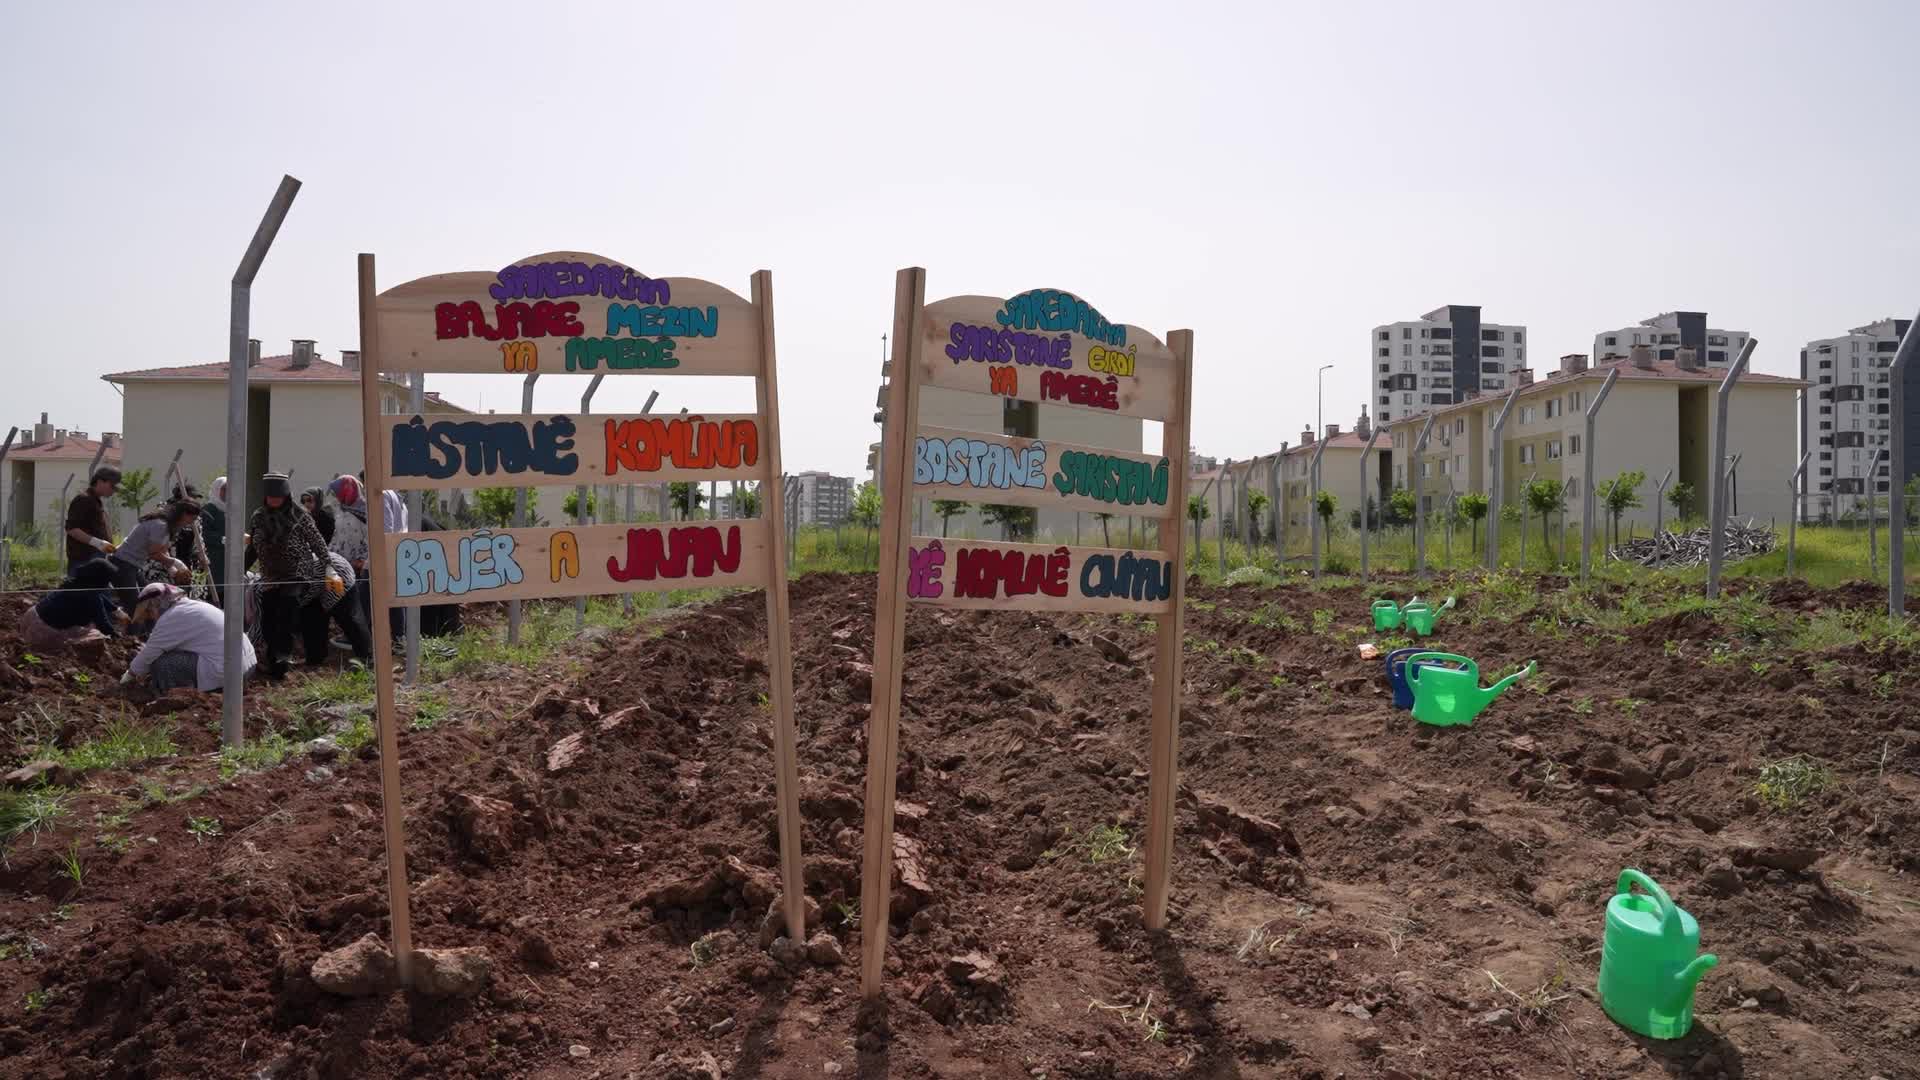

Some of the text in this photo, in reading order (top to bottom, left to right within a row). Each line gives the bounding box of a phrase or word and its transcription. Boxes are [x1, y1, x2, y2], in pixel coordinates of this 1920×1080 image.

[606, 303, 718, 338] MEZIN
[502, 336, 680, 372] YA AMEDÊ
[989, 366, 1119, 410] YA AMEDÊ
[605, 415, 759, 476] KOMÛNA
[912, 436, 1047, 490] BOSTANÊ
[396, 528, 524, 597] BAJÊR
[550, 531, 580, 583] A
[907, 539, 946, 599] YÊ
